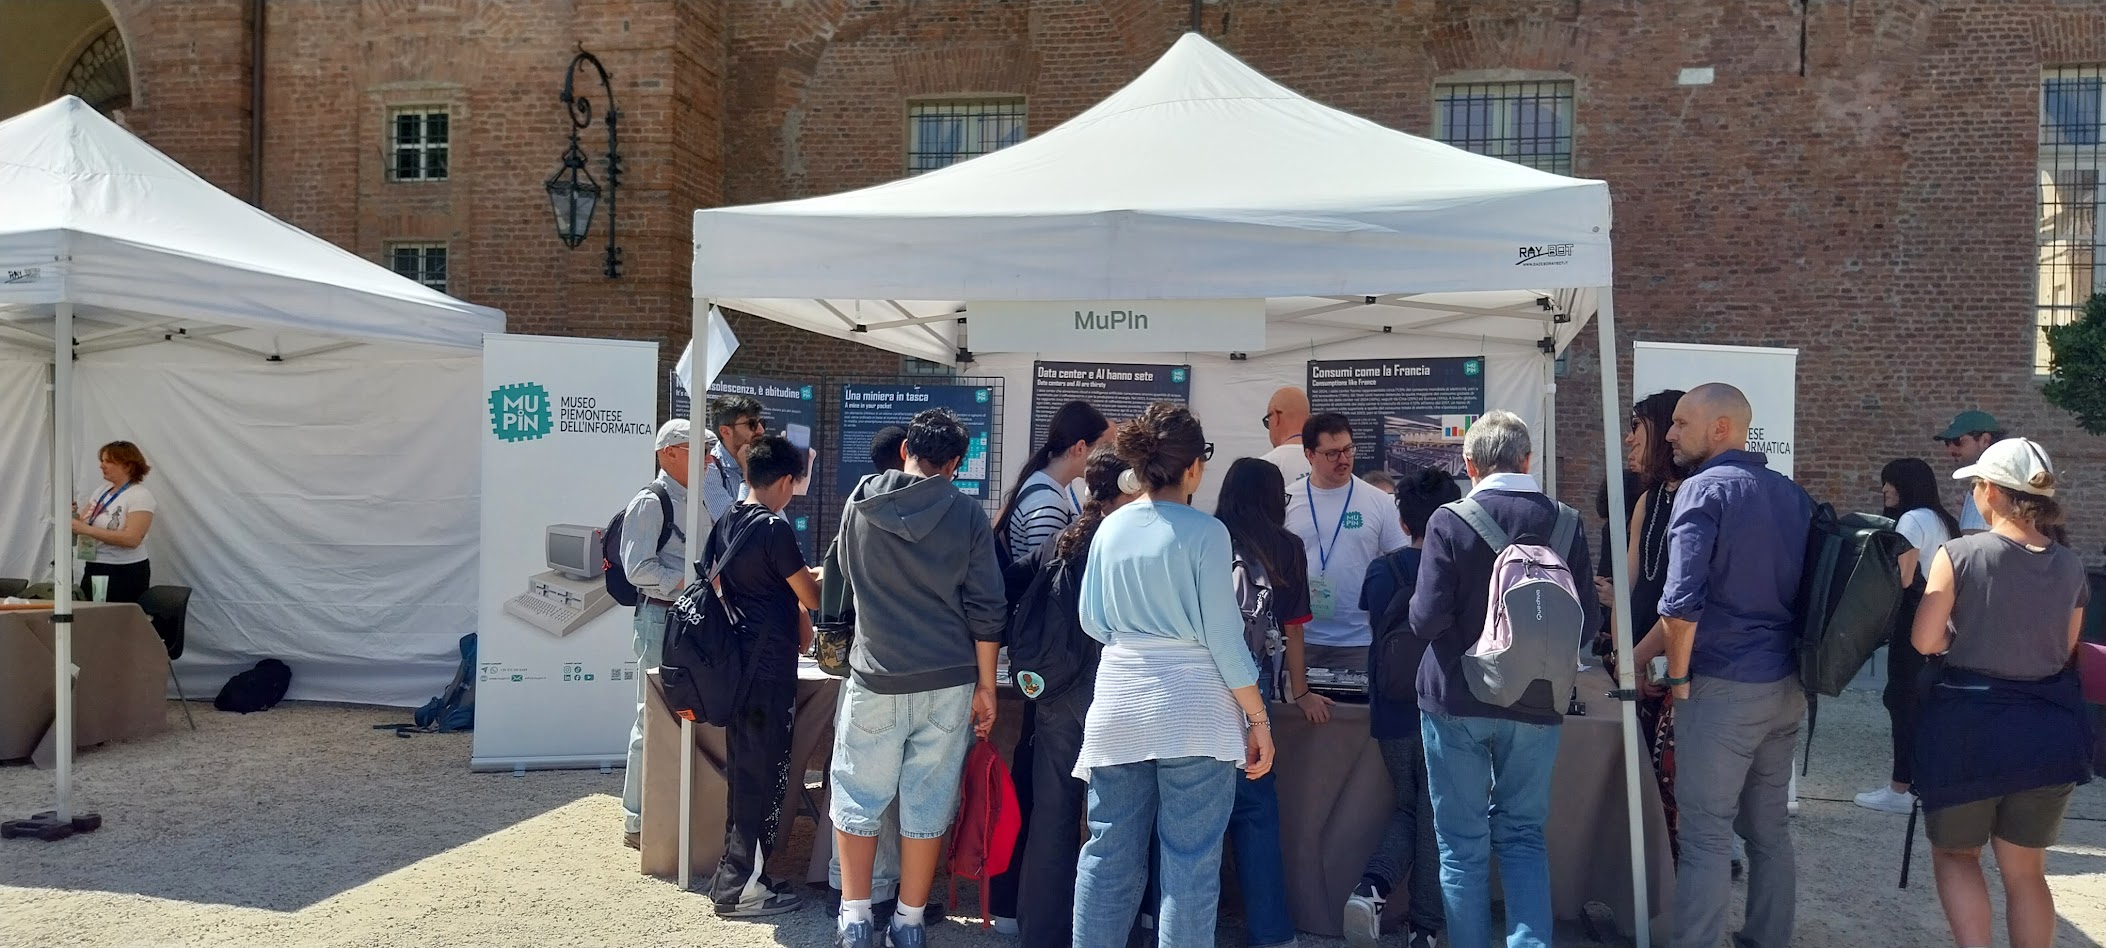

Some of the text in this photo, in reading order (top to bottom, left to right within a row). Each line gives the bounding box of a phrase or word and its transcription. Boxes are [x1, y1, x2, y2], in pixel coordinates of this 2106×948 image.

[1519, 243, 1574, 258] RAY BOT
[1037, 366, 1154, 382] Data center e AI hanno sete
[1312, 364, 1431, 378] Consumi come la Francia
[709, 380, 757, 396] solescenza,
[758, 385, 764, 396] è
[765, 385, 800, 399] abitudine
[1090, 381, 1107, 389] thirsty
[1312, 379, 1347, 387] Consumptions
[1358, 378, 1377, 386] France
[561, 396, 596, 408] MUSEO
[845, 389, 929, 402] Una miniera in tasca
[503, 394, 539, 413] MU
[561, 408, 623, 422] PIEMONTESE
[560, 420, 652, 435] DELL'INFORMATICA
[1748, 428, 1765, 440] ESE
[1745, 441, 1791, 454] ORMATICA
